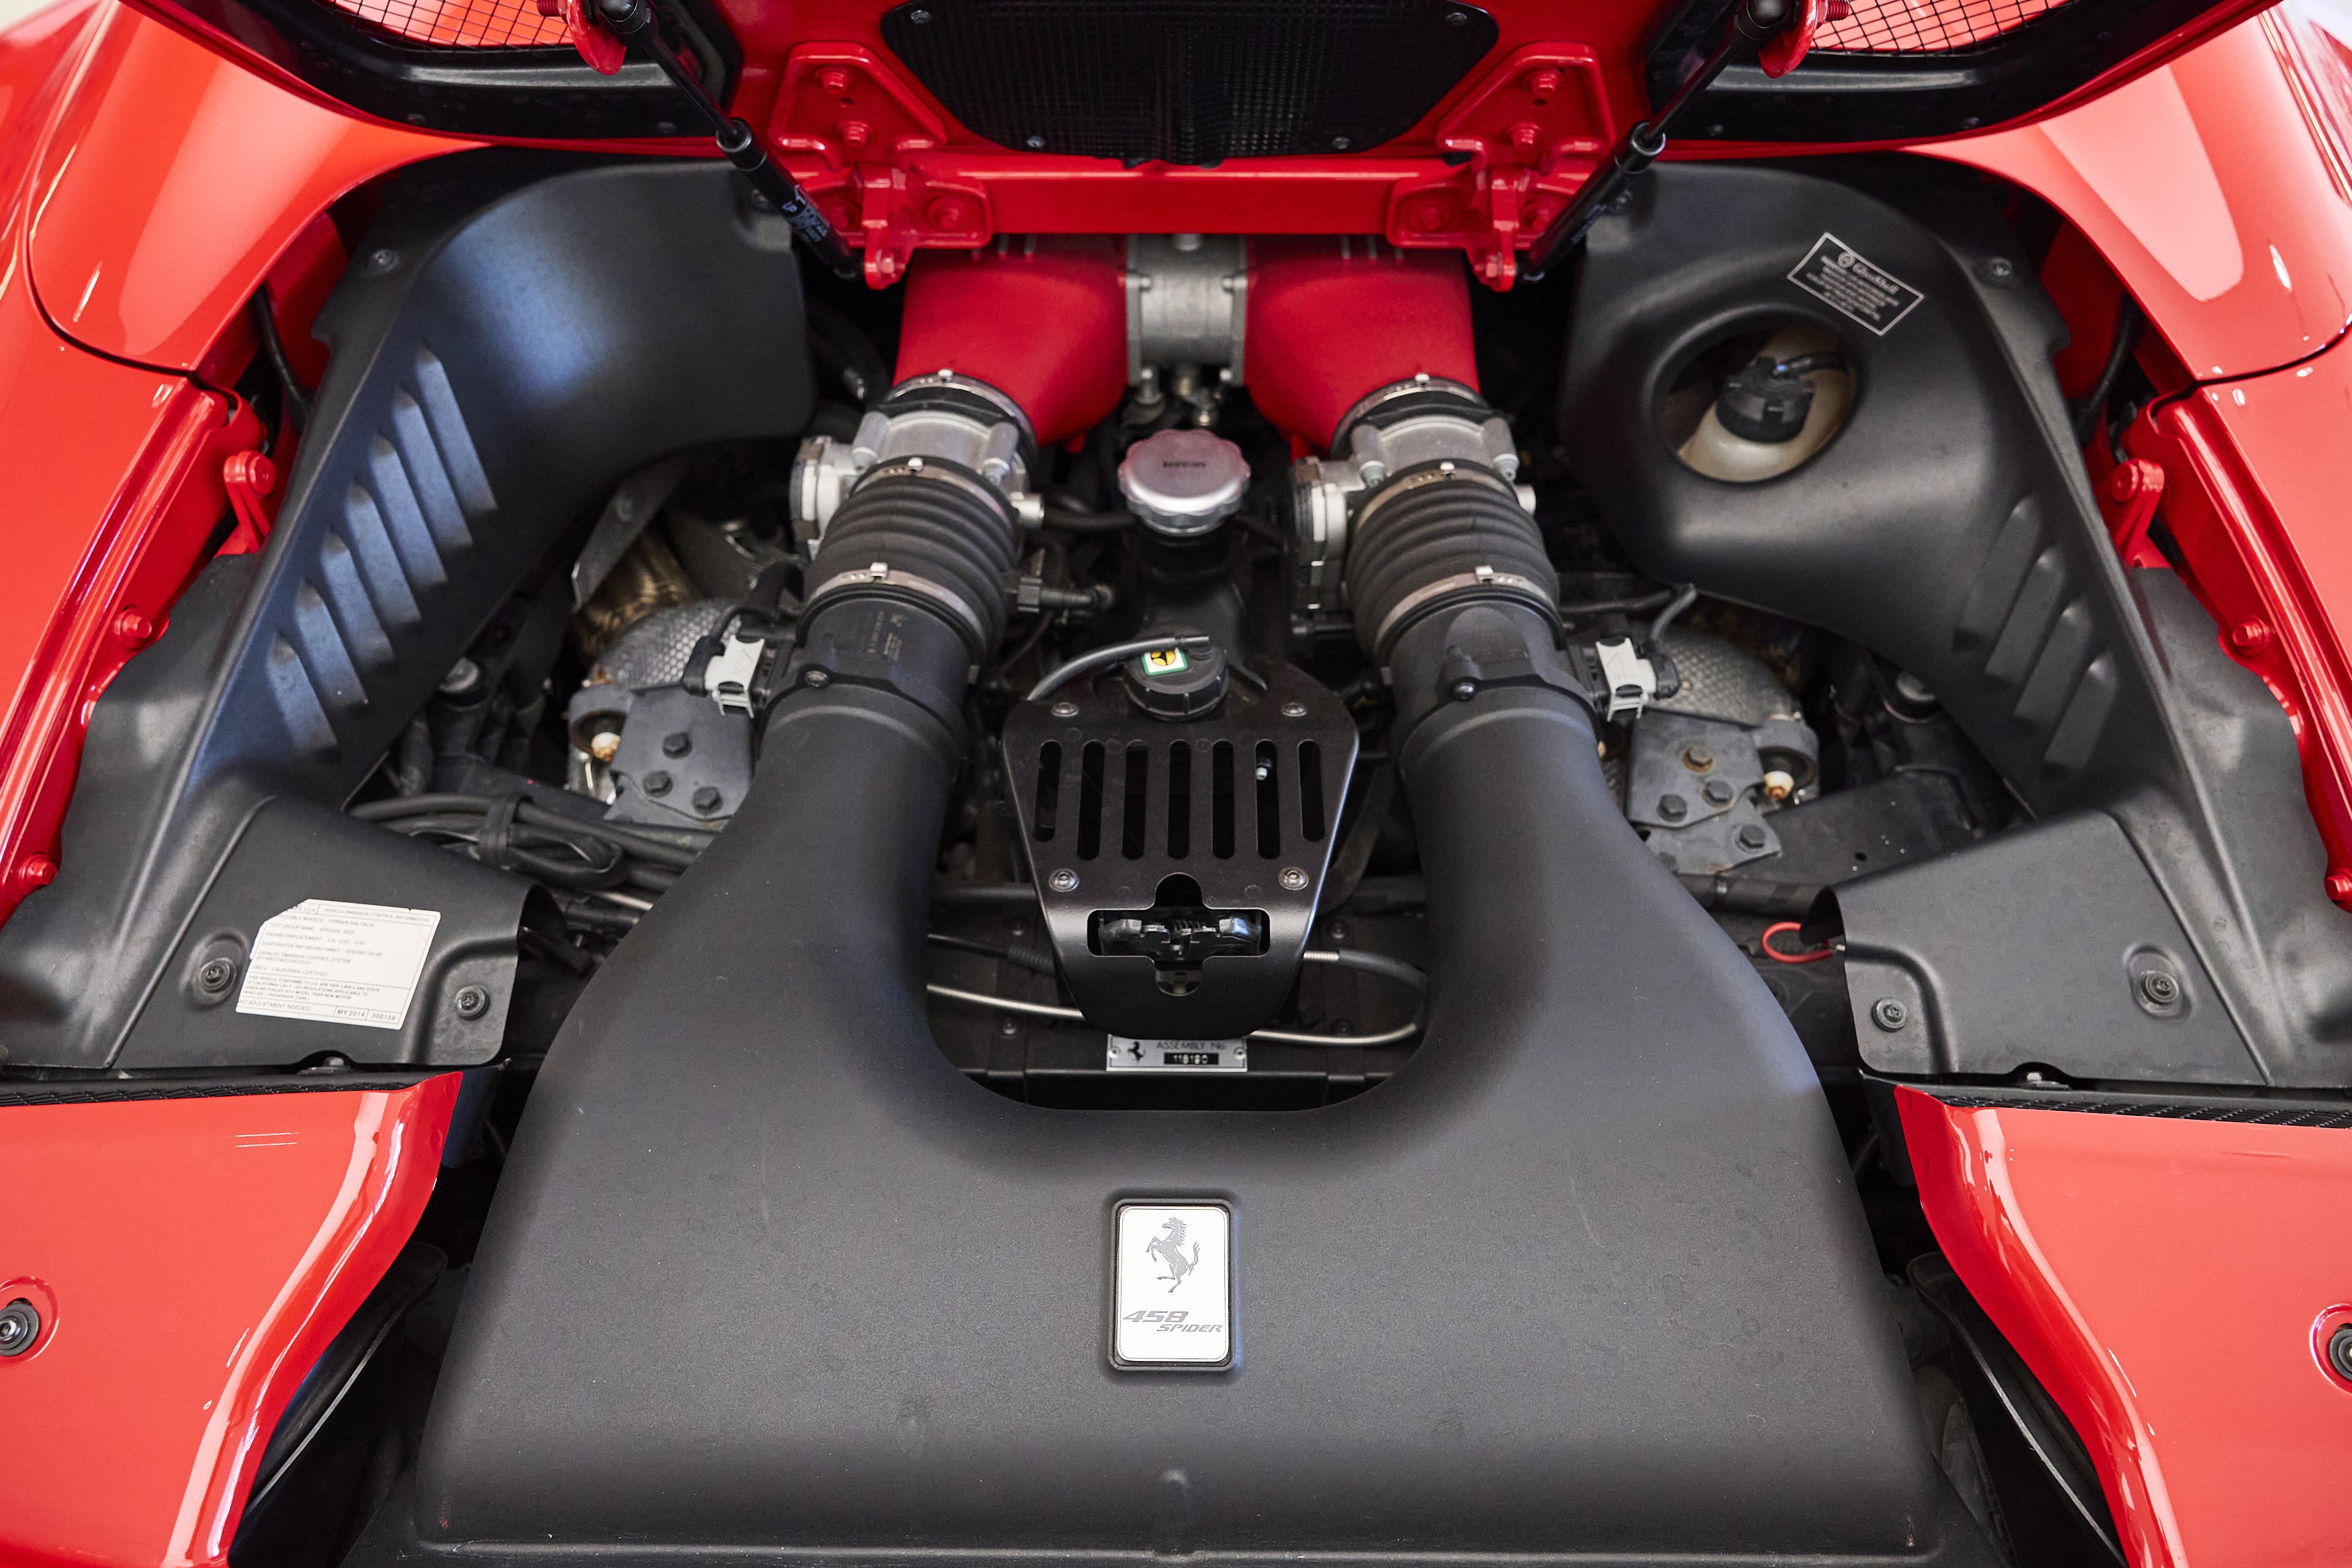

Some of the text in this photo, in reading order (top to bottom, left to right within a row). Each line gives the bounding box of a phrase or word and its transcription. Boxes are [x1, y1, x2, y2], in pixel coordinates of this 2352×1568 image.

[248, 999, 286, 1009] ADJUSTMENT
[1123, 1310, 1189, 1323] 458
[1156, 1324, 1223, 1333] SPIDER
